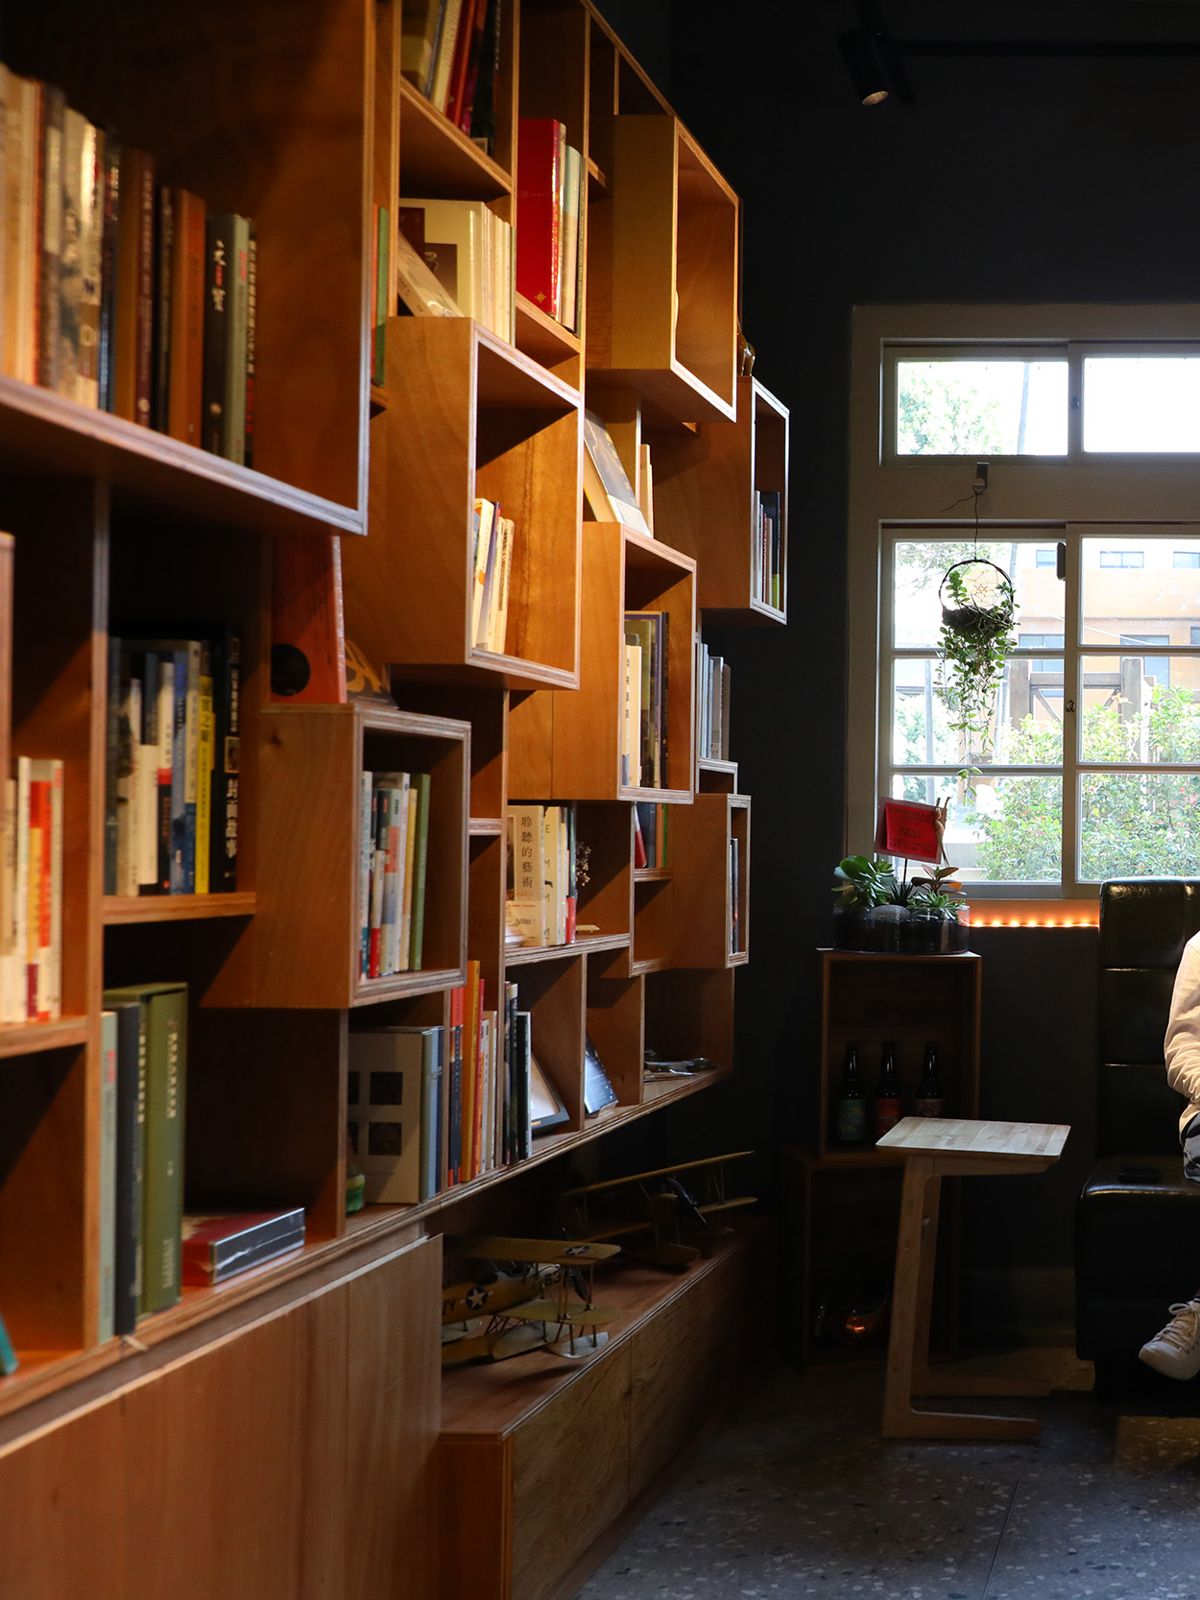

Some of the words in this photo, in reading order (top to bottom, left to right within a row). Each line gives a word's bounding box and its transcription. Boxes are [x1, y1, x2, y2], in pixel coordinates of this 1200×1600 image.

[521, 816, 533, 888] 聆聽的藝術
